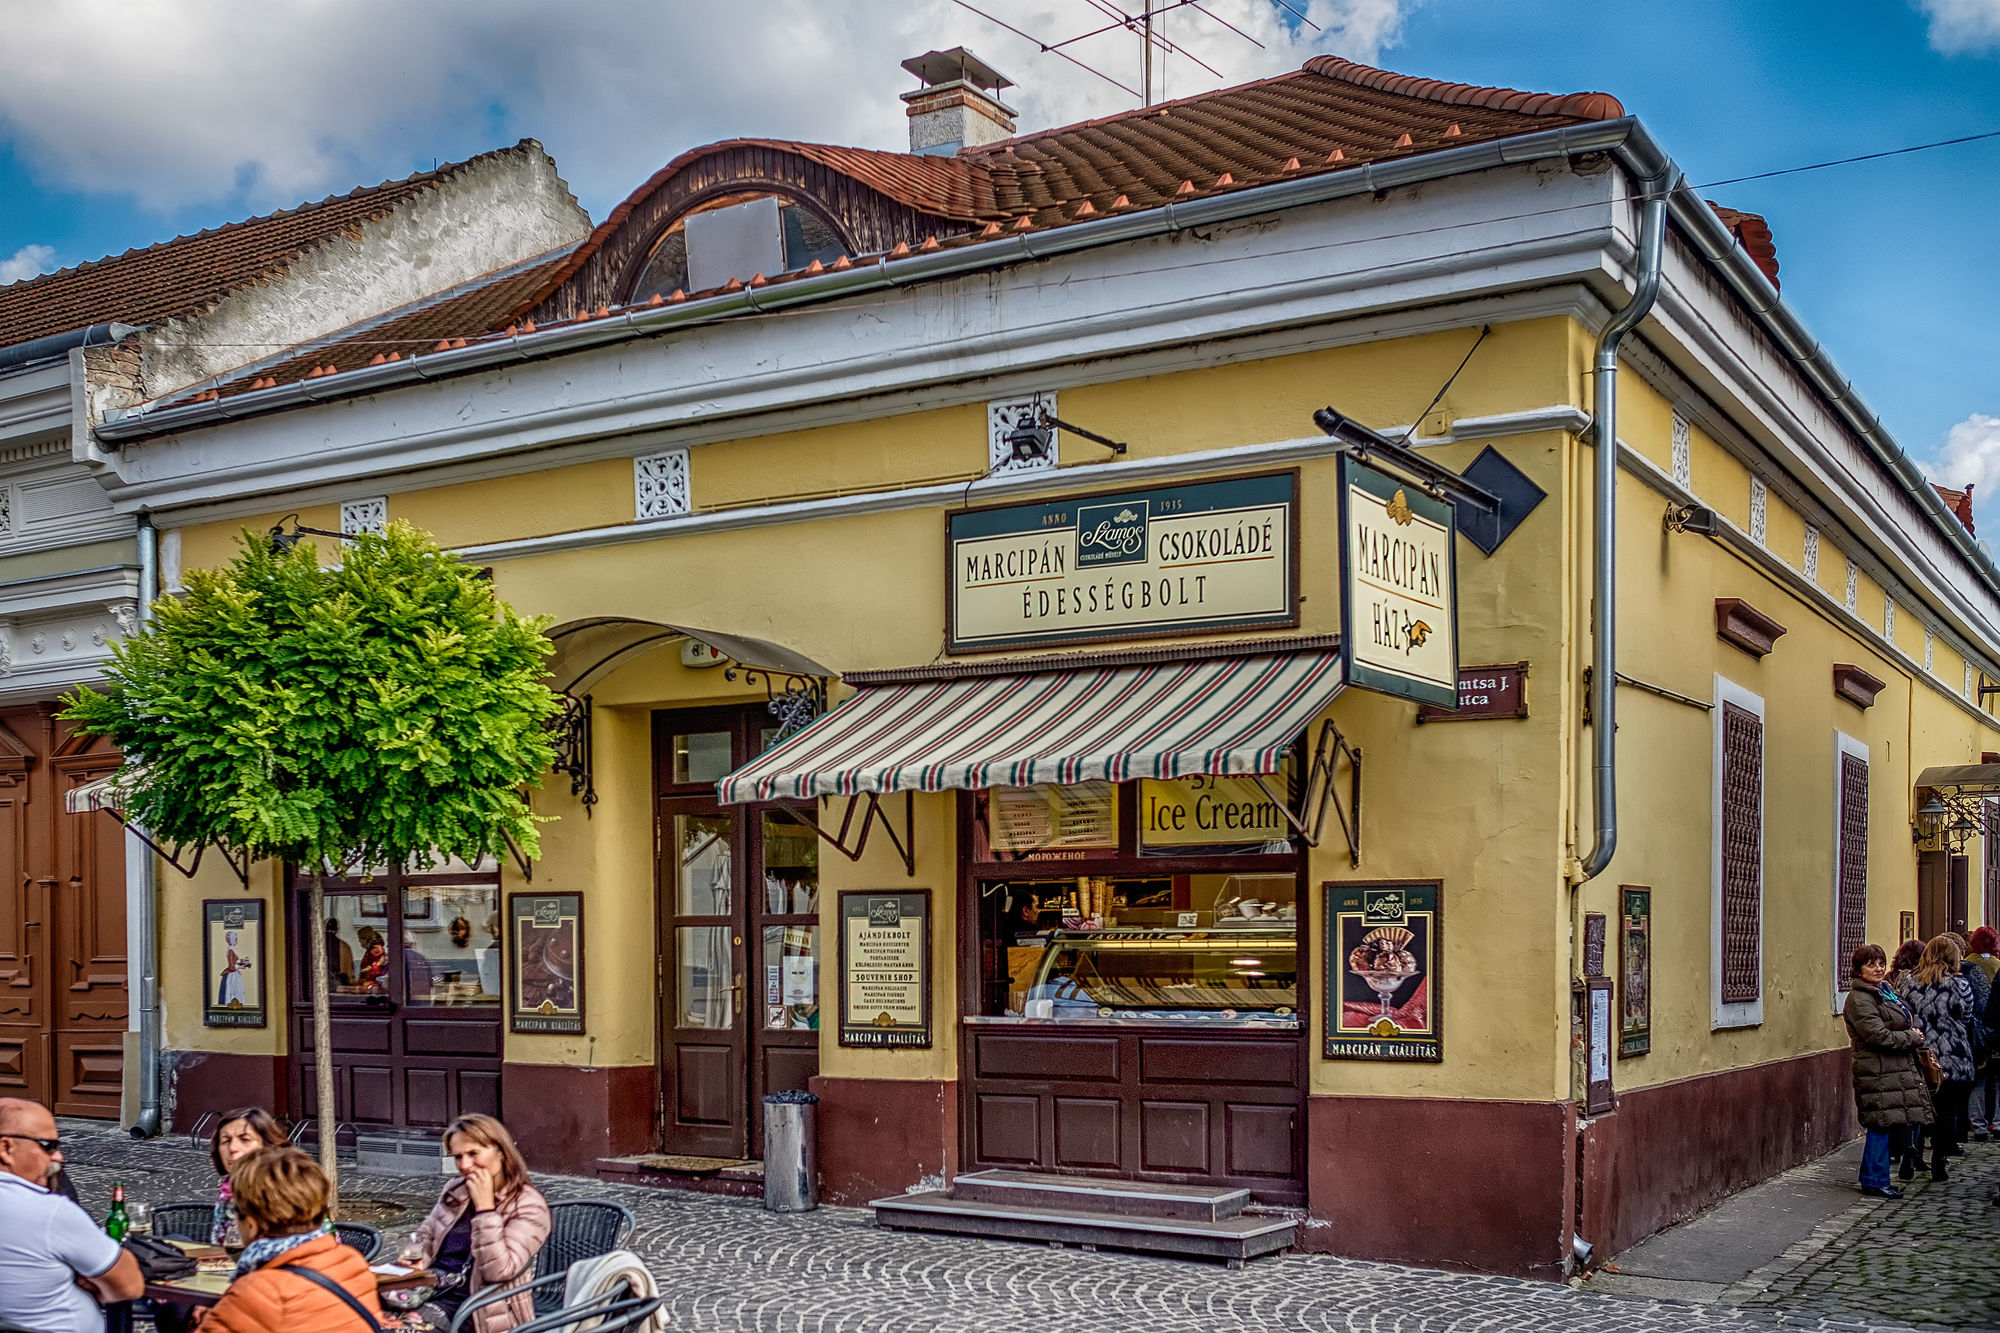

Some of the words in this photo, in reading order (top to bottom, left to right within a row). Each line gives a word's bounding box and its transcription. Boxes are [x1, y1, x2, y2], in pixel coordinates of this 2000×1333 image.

[1041, 512, 1067, 526] ANNO
[1160, 499, 1182, 513] 1935
[1080, 520, 1144, 554] Szamos
[1158, 516, 1273, 562] CSOKOLÁDÉ
[966, 540, 1066, 583] MARCIPÁN
[1358, 523, 1440, 599] MARCIPÁN
[1022, 574, 1208, 620] ÉDESSÉGBOLT
[1372, 598, 1400, 650] HÁZ
[1458, 678, 1497, 690] mtsa
[1150, 796, 1186, 831] Ice
[1196, 794, 1279, 830] Cream
[1028, 851, 1086, 861] МОРОЖЕНОЕ
[858, 930, 911, 941] AJÁNDÉKBOLT
[856, 973, 892, 981] SOUVENIR
[894, 973, 913, 981] SHOP
[844, 1032, 882, 1043] MARCIPÁN
[887, 1032, 926, 1044] KIÁLLÍTÁS
[1332, 1042, 1381, 1056] MARCIPÁN
[1388, 1043, 1437, 1058] KIÁLLÍTÁS
